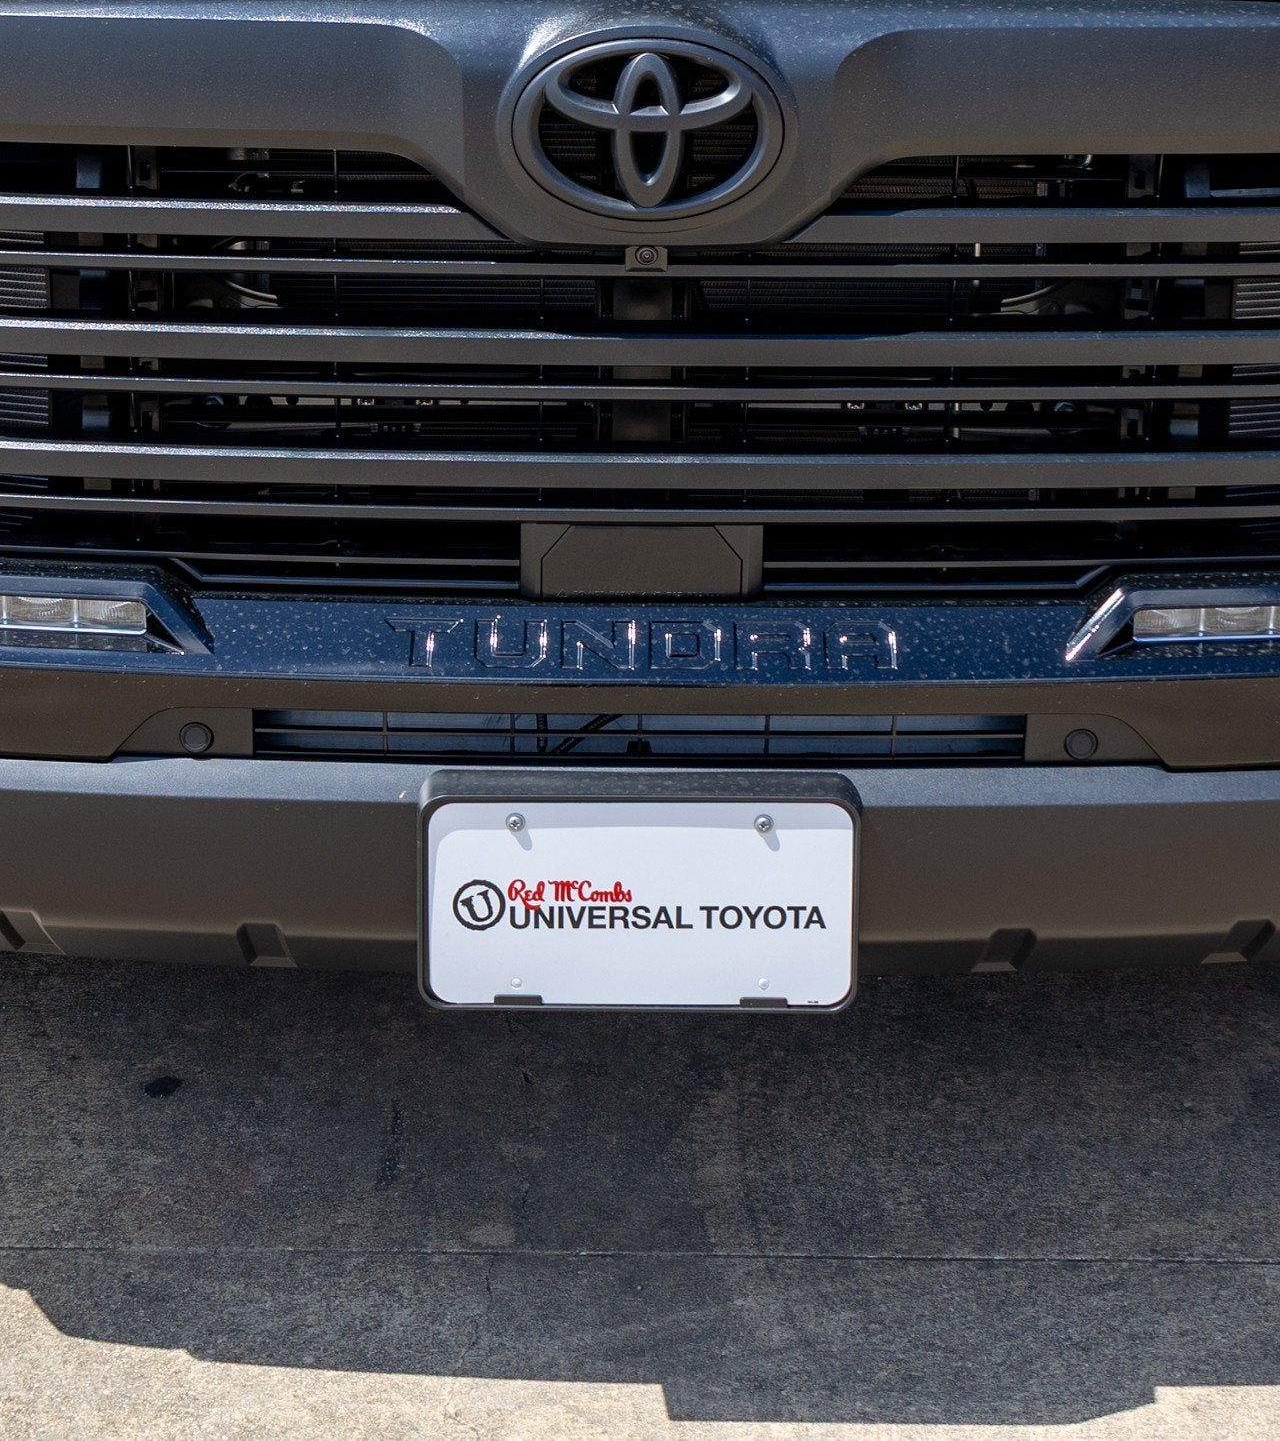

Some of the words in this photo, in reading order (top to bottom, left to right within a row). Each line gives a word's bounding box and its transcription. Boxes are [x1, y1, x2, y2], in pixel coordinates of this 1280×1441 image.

[384, 616, 899, 671] TUNDRA
[508, 879, 545, 910] Red
[548, 879, 632, 903] McCombs
[509, 905, 693, 930] UNIVERSAL
[700, 905, 827, 930] TOYOTA
